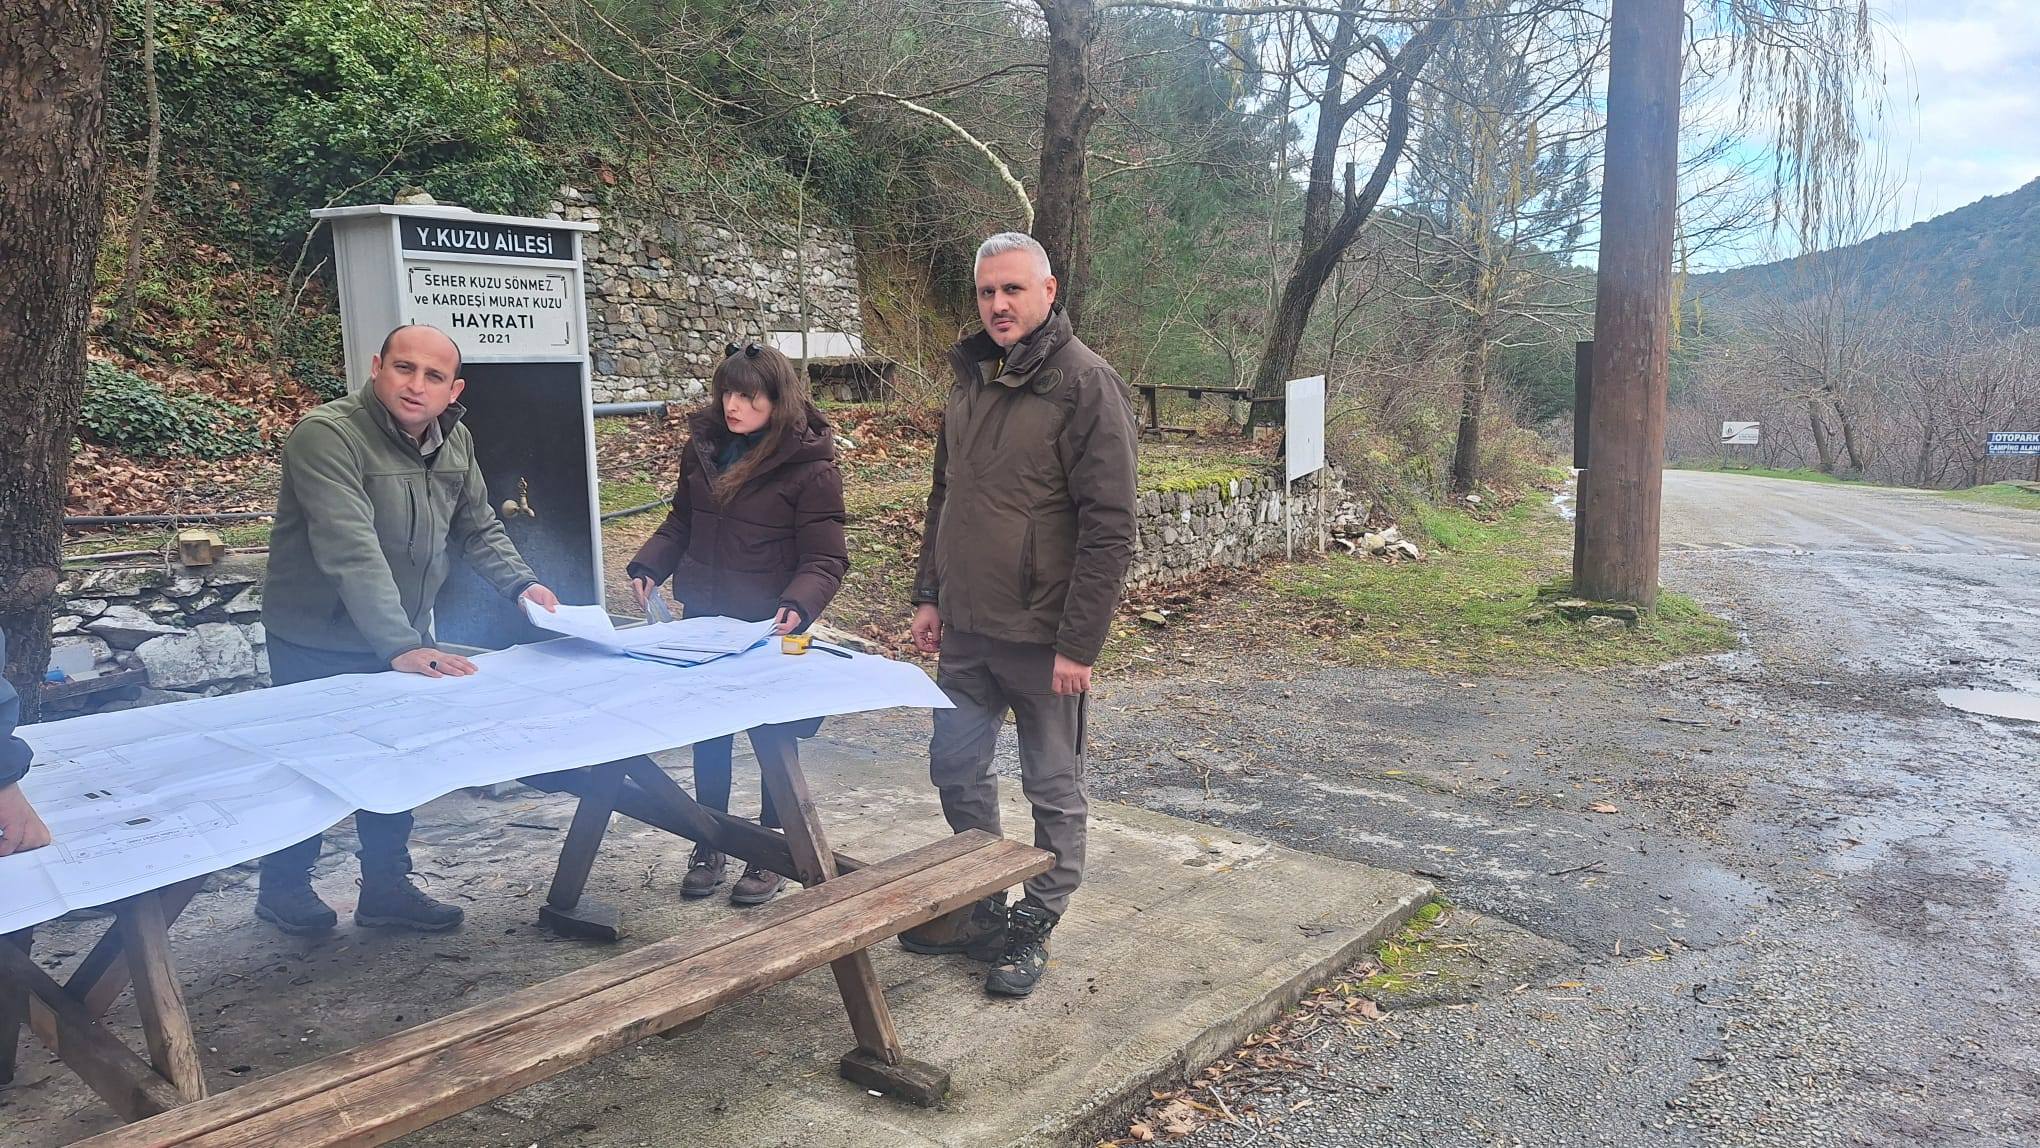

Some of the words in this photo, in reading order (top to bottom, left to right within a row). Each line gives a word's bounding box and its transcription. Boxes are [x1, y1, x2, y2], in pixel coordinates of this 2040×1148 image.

[416, 226, 489, 249] Y.KUZU
[495, 229, 553, 254] AİLESİ
[424, 274, 466, 288] SEHER
[470, 276, 501, 289] KUZU
[504, 276, 553, 291] SÖNMEZ
[415, 295, 428, 305] ve
[432, 292, 486, 307] KARDEŞİ
[489, 295, 529, 308] MURAT
[533, 298, 562, 309] KUZU
[452, 312, 534, 329] HAYRATI
[479, 334, 511, 344] 2021
[1995, 433, 2040, 442] OTOPARK
